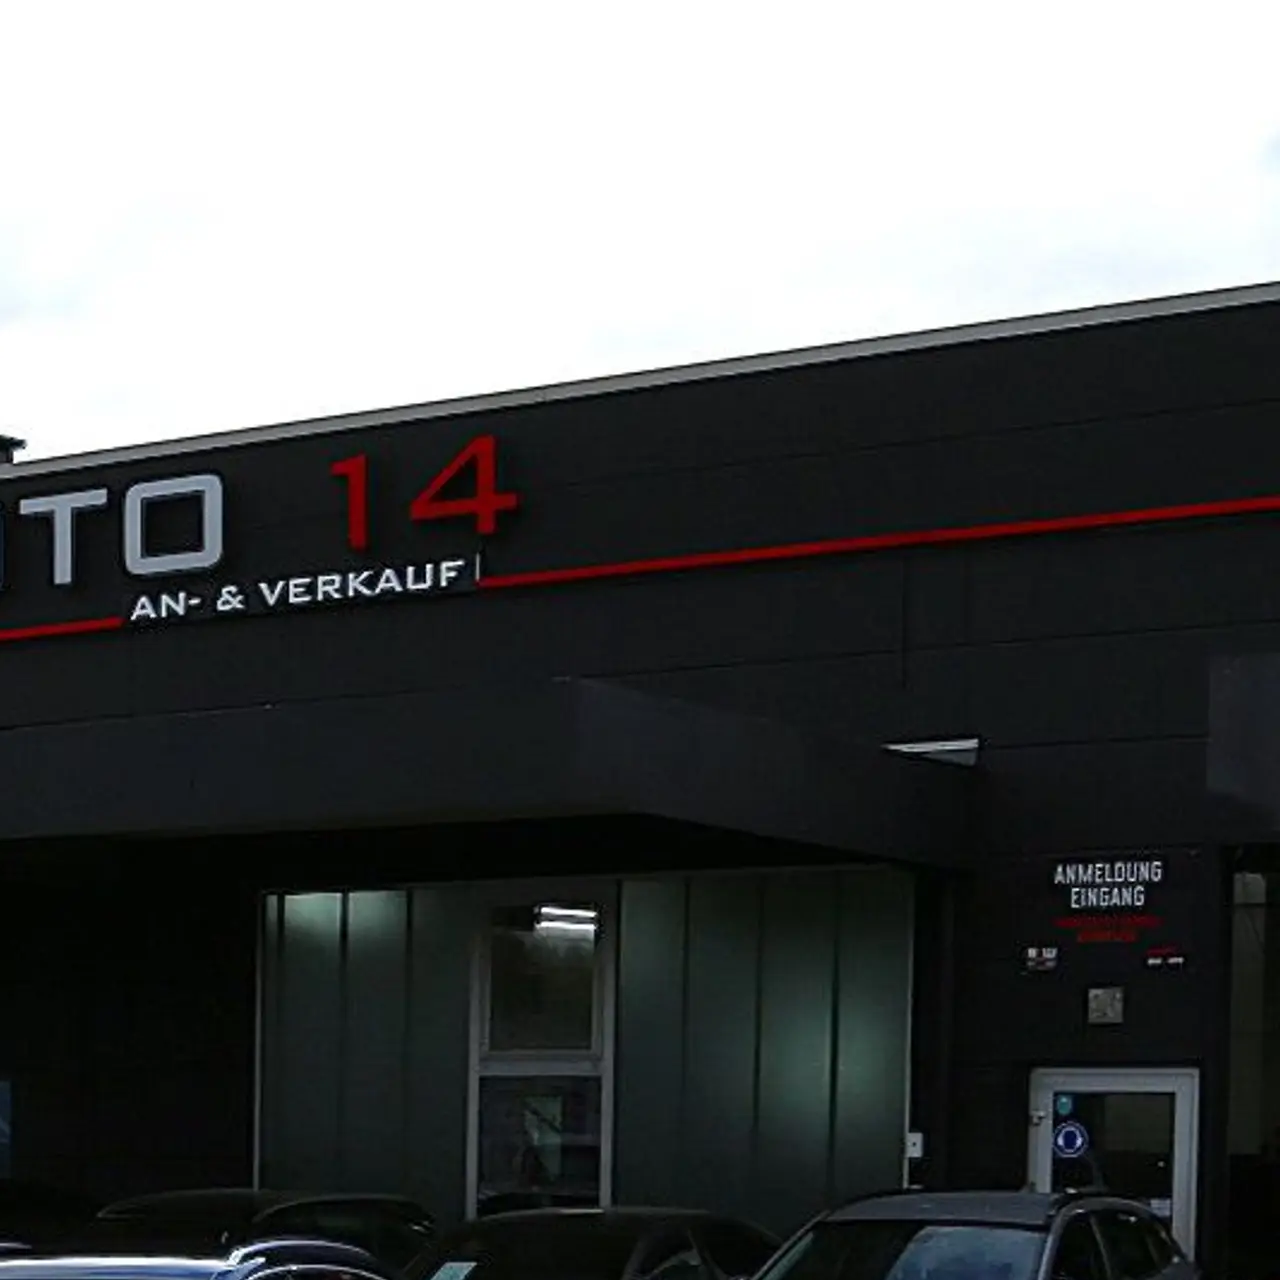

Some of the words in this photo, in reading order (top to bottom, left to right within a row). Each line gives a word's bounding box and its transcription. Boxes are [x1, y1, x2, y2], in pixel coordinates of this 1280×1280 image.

[329, 434, 521, 552] 14
[130, 591, 202, 621] AN-
[215, 584, 245, 612] &
[258, 559, 466, 607] VERKAUF
[1053, 860, 1163, 885] ANMELDUNG
[1070, 885, 1145, 909] EINGANG
